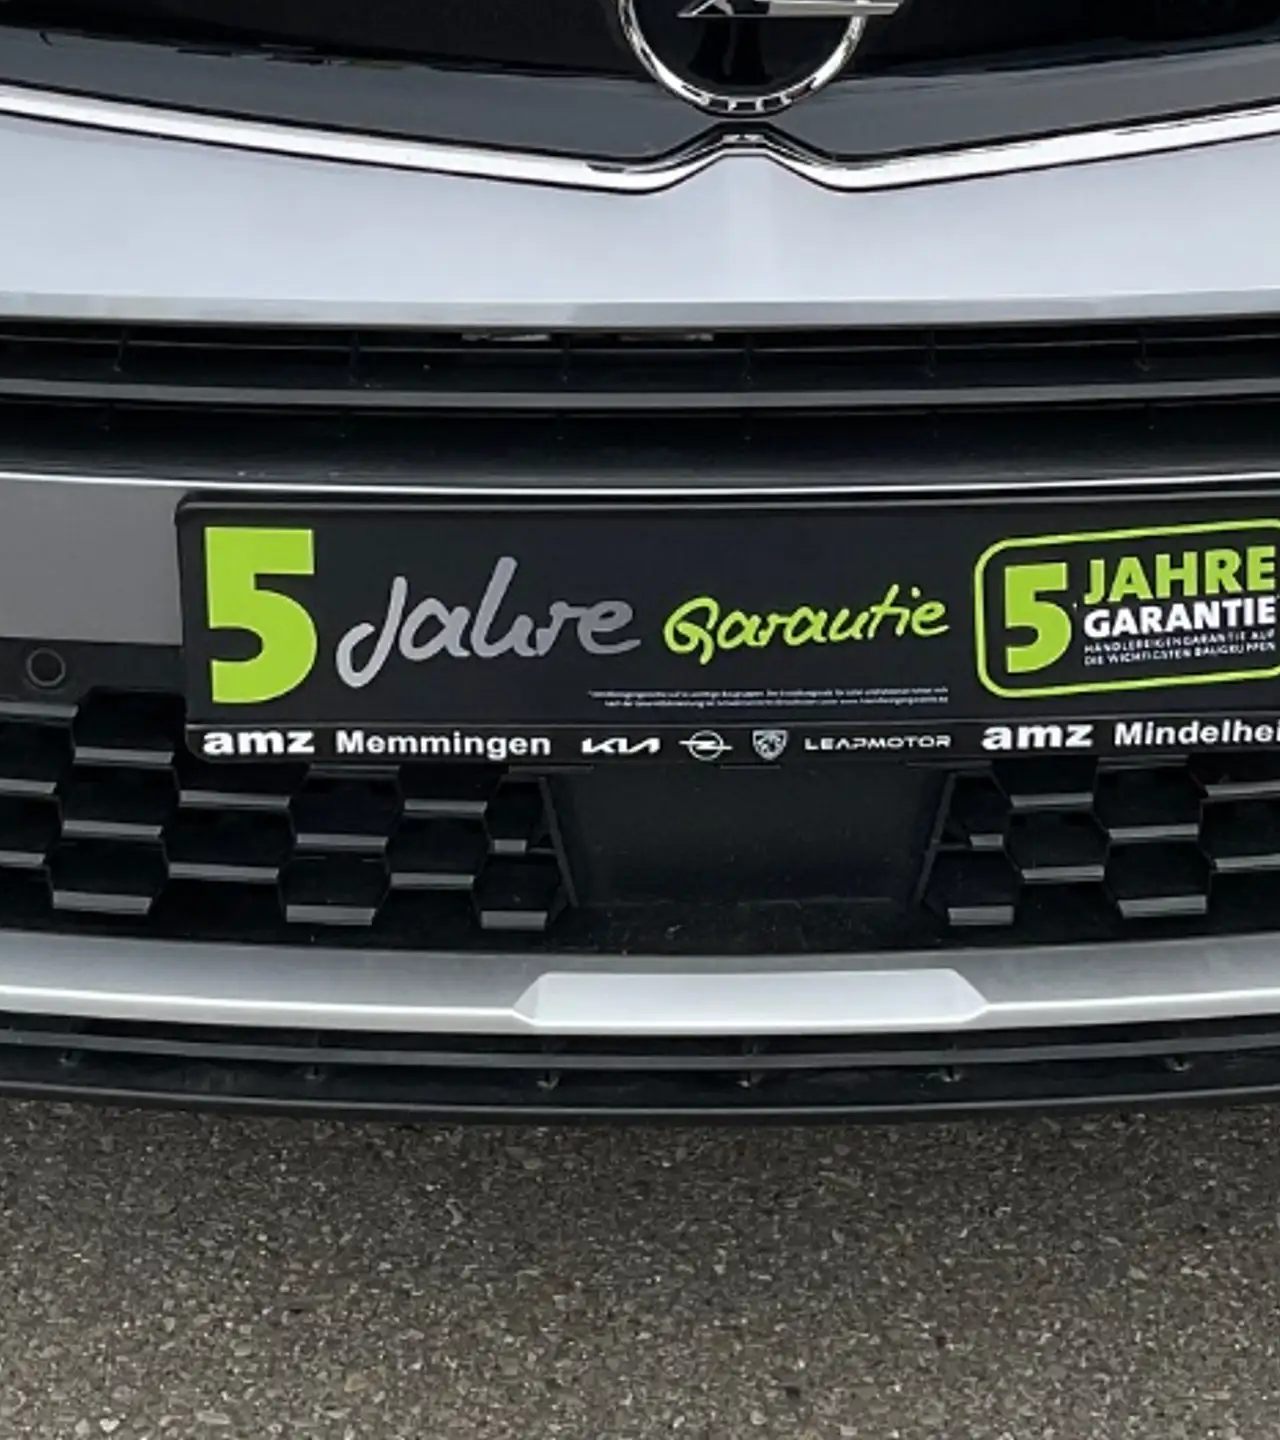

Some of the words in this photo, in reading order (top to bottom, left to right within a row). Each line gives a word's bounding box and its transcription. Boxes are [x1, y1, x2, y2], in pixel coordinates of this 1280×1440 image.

[205, 527, 317, 703] 5
[336, 556, 641, 688] Jahre
[1005, 562, 1071, 673] 5
[1084, 545, 1276, 605] JAHRE
[203, 730, 315, 754] amz
[336, 730, 551, 760] Memmingen
[581, 737, 660, 754] KIA
[804, 735, 951, 751] LEAPMOTOR
[981, 723, 1094, 750] amz
